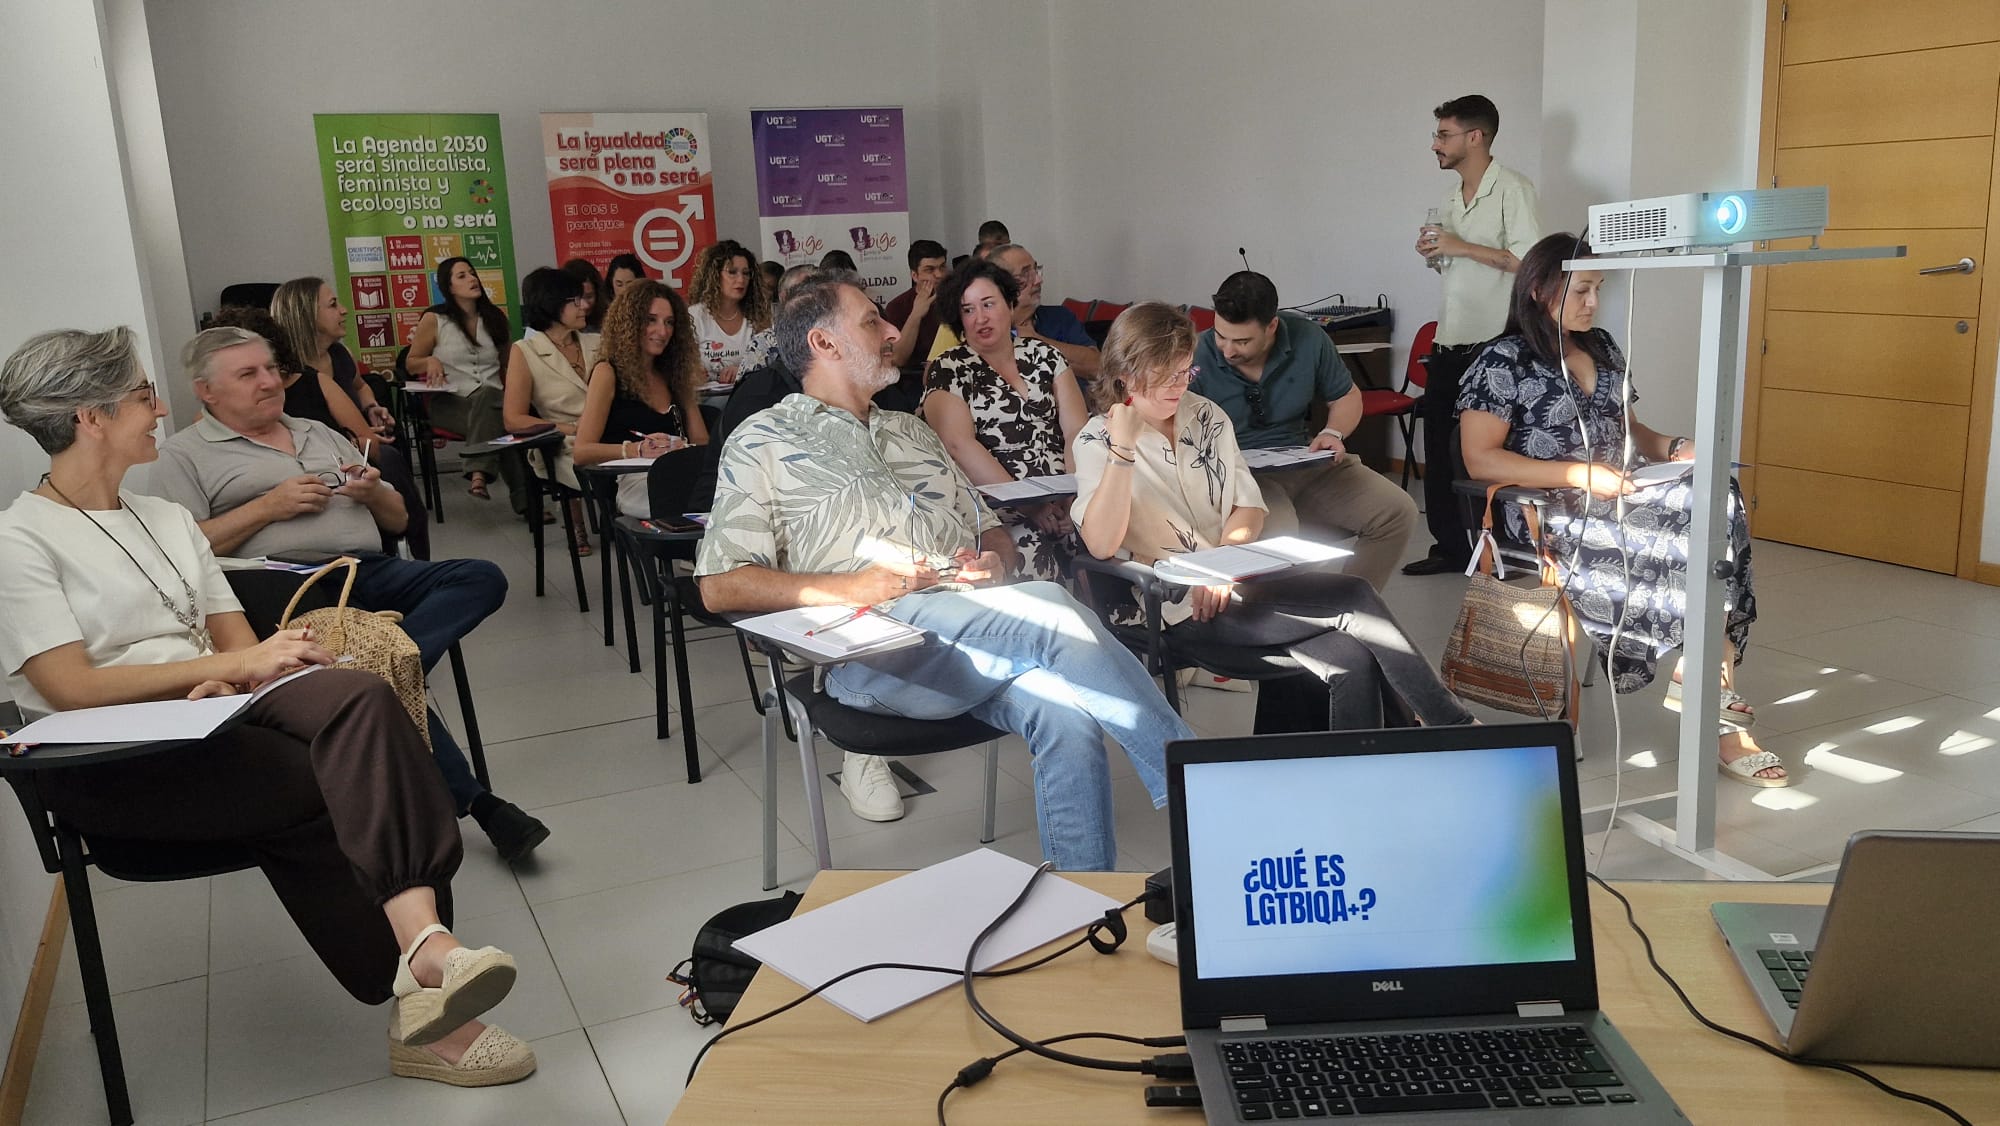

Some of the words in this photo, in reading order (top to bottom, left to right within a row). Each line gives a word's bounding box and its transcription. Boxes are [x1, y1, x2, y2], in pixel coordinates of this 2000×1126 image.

[332, 136, 356, 154] La
[362, 135, 438, 158] Agenda
[442, 136, 487, 152] 2030
[557, 132, 580, 150] La
[584, 131, 665, 152] igualdad
[336, 155, 376, 172] será
[382, 153, 490, 172] sindicalista,
[560, 154, 599, 171] será
[604, 153, 656, 172] plena
[770, 157, 786, 165] UGT
[338, 174, 430, 192] feminista
[438, 177, 450, 194] y
[614, 172, 626, 186] o
[632, 172, 656, 185] no
[660, 168, 700, 184] será
[340, 194, 442, 214] ecologista
[564, 204, 578, 216] El
[582, 204, 607, 215] ODS
[610, 203, 618, 214] 5
[404, 214, 416, 229] o
[423, 214, 448, 229] no
[454, 210, 497, 228] será
[567, 217, 624, 232] persigue:
[357, 278, 363, 288] 4
[398, 274, 403, 284] 5
[362, 354, 372, 364] 12
[1244, 848, 1308, 892] ¿QUÉ
[1315, 854, 1346, 887] ES
[1245, 888, 1376, 926] LGTBIQA+?
[1372, 980, 1404, 991] DELL
